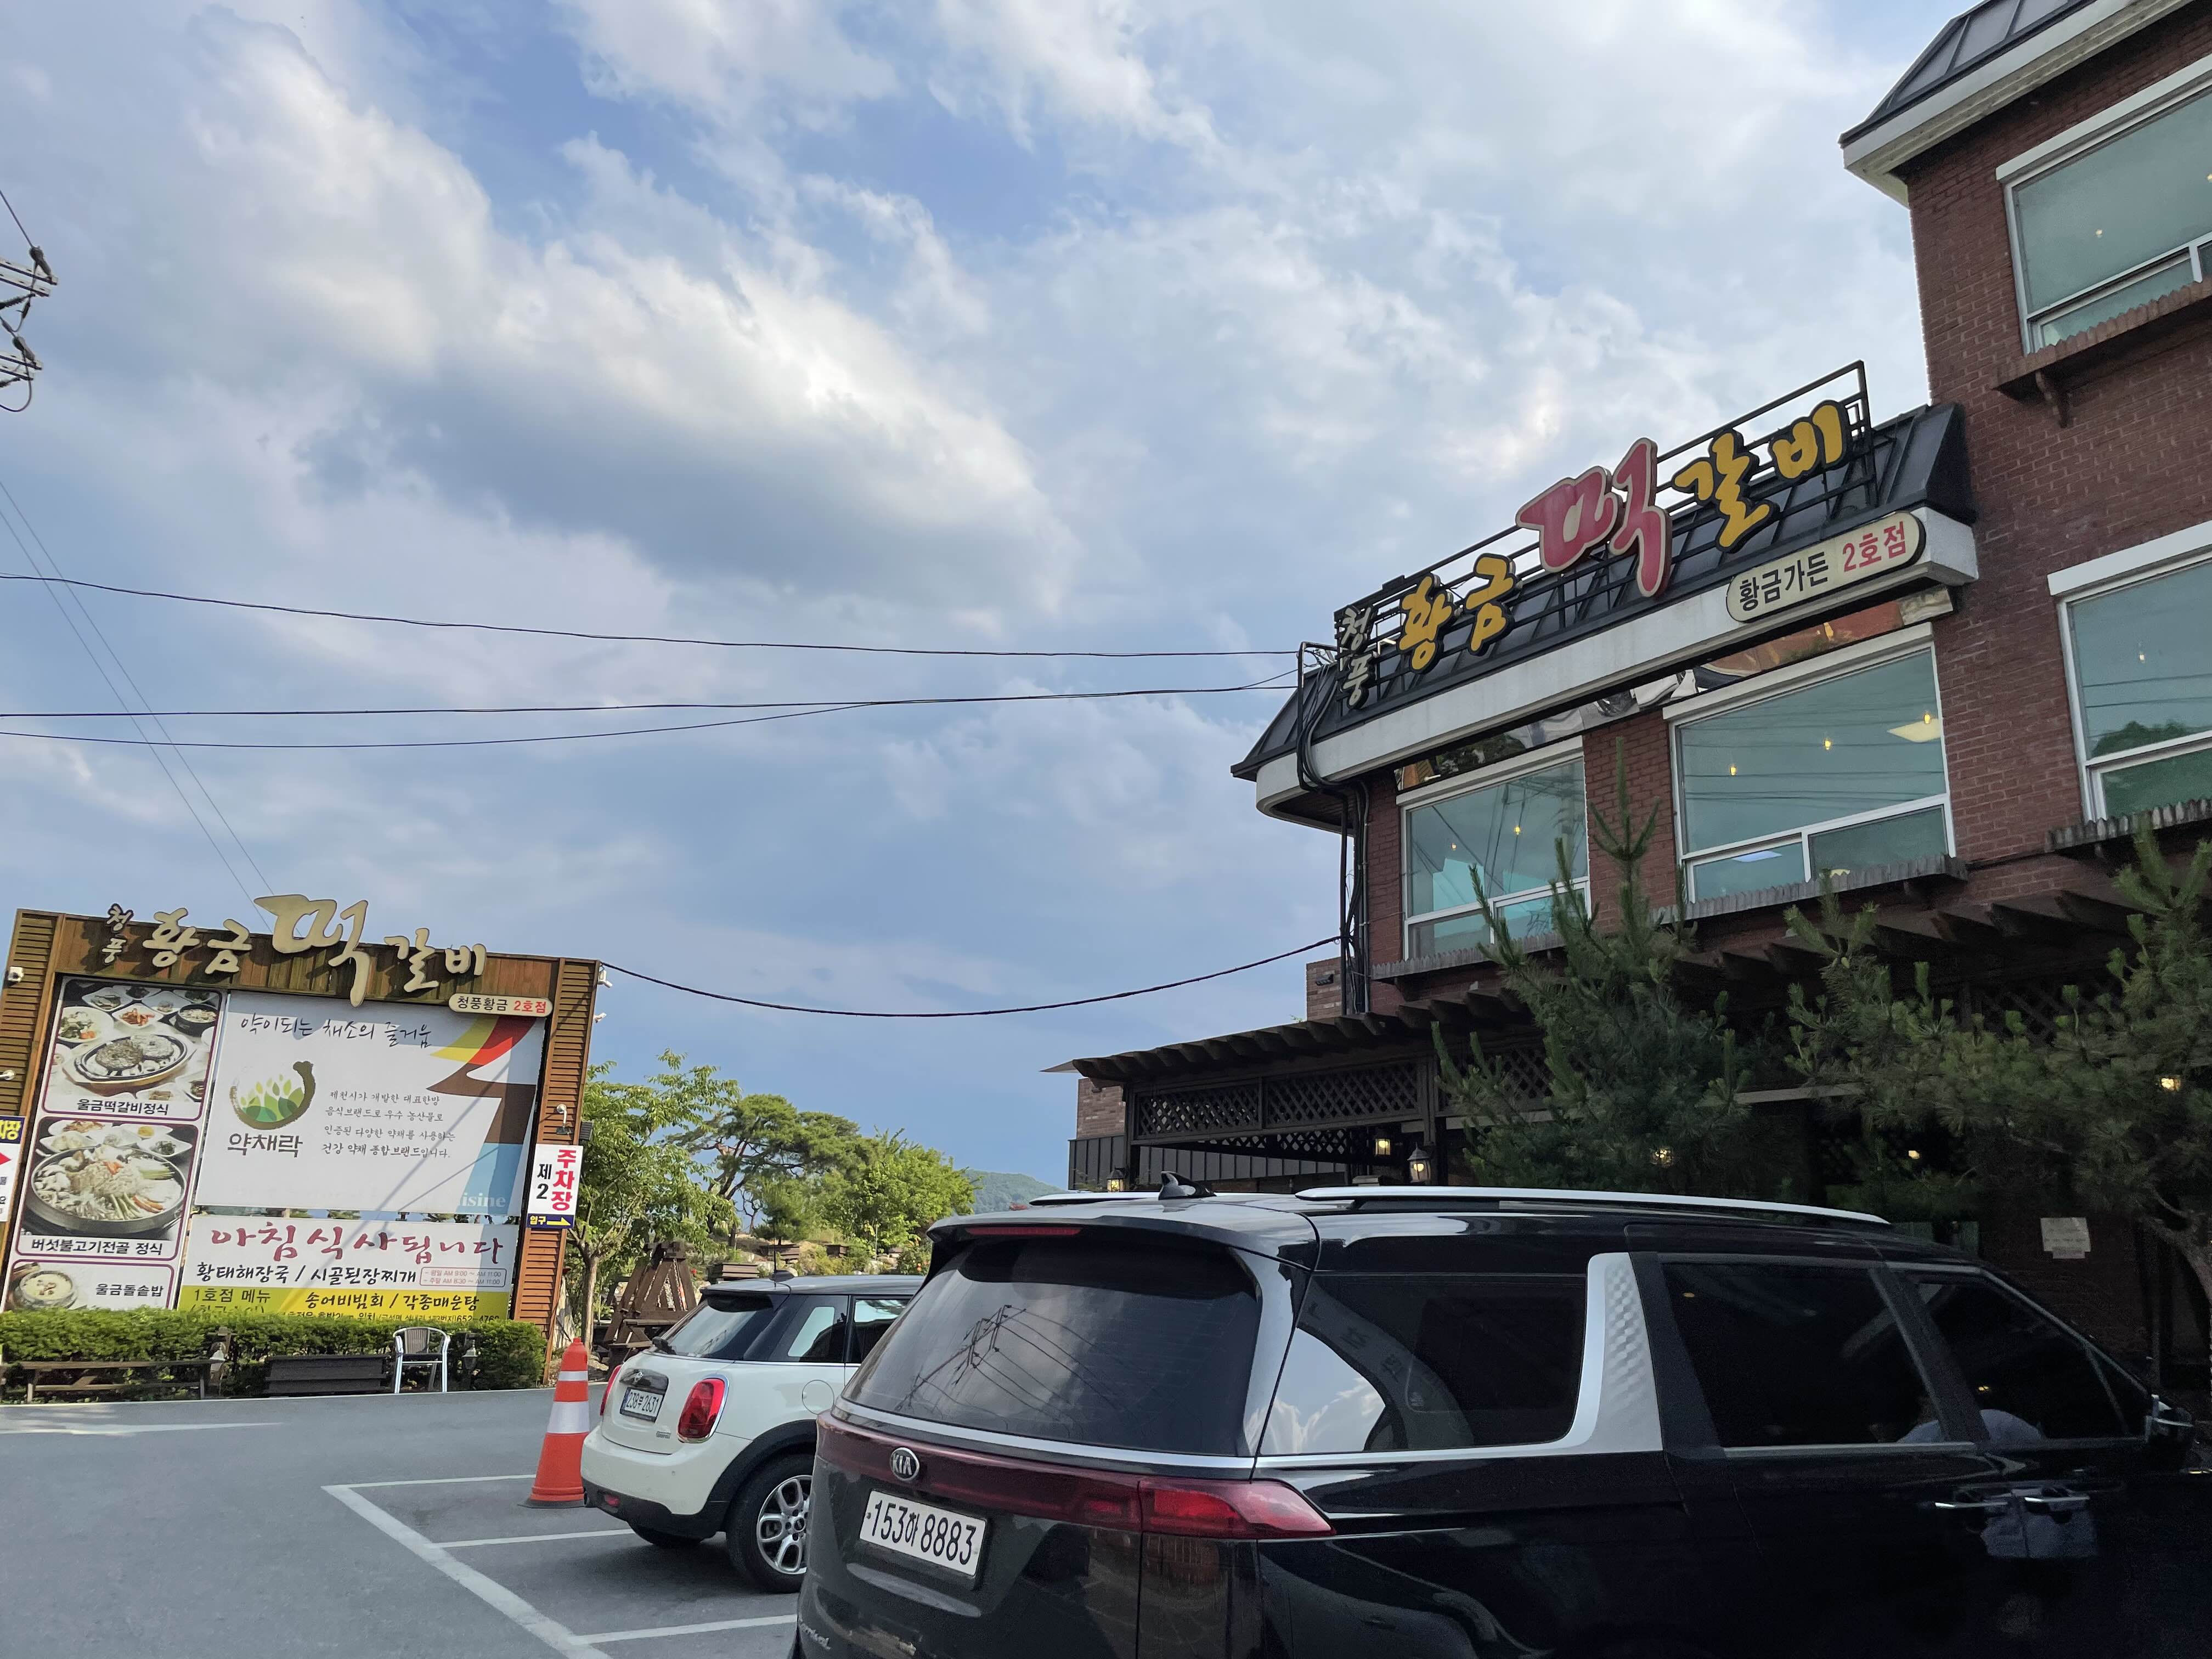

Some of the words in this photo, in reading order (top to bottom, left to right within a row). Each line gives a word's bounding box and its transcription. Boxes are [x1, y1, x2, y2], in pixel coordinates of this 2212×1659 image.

[1738, 551, 1830, 612] 황금가든
[1842, 521, 1908, 572] 2호점
[101, 903, 133, 964] 청풍
[457, 996, 508, 1012] 청풍황금
[514, 998, 547, 1014] 2호점
[241, 1013, 312, 1035] 약이되는
[323, 1019, 375, 1039] 채소의
[384, 1022, 431, 1049] 즐거움
[330, 1090, 367, 1101] 제천시가
[371, 1092, 399, 1103] 개발한
[403, 1095, 439, 1105] 대표한방
[77, 1099, 169, 1116] 울금떡갈비정식
[385, 1110, 403, 1120] 우수
[408, 1111, 443, 1122] 농산물로
[324, 1125, 352, 1136] 인증된
[356, 1127, 383, 1138] 다양한
[387, 1129, 415, 1140] 약채를
[419, 1130, 456, 1142] 사용하는
[227, 1132, 303, 1158] 약채락
[322, 1142, 343, 1154] 건강
[348, 1143, 366, 1155] 약채
[370, 1145, 390, 1156] 종합
[551, 1149, 577, 1211] 주차장
[529, 1215, 547, 1226] 입구
[31, 1238, 130, 1255] 버섯불고기전골
[136, 1242, 163, 1256] 정식
[197, 1262, 290, 1284] 황태해장국
[311, 1267, 416, 1285] 시골된장찌개
[95, 1283, 165, 1297] 울금돌솥밥
[194, 1288, 233, 1303] 1호점
[241, 1289, 271, 1304] 메뉴
[305, 1291, 384, 1310] 송어비빔회
[403, 1294, 479, 1311] 각종매운탕
[892, 1453, 912, 1476] KIA
[871, 1499, 977, 1565] 153하8883
